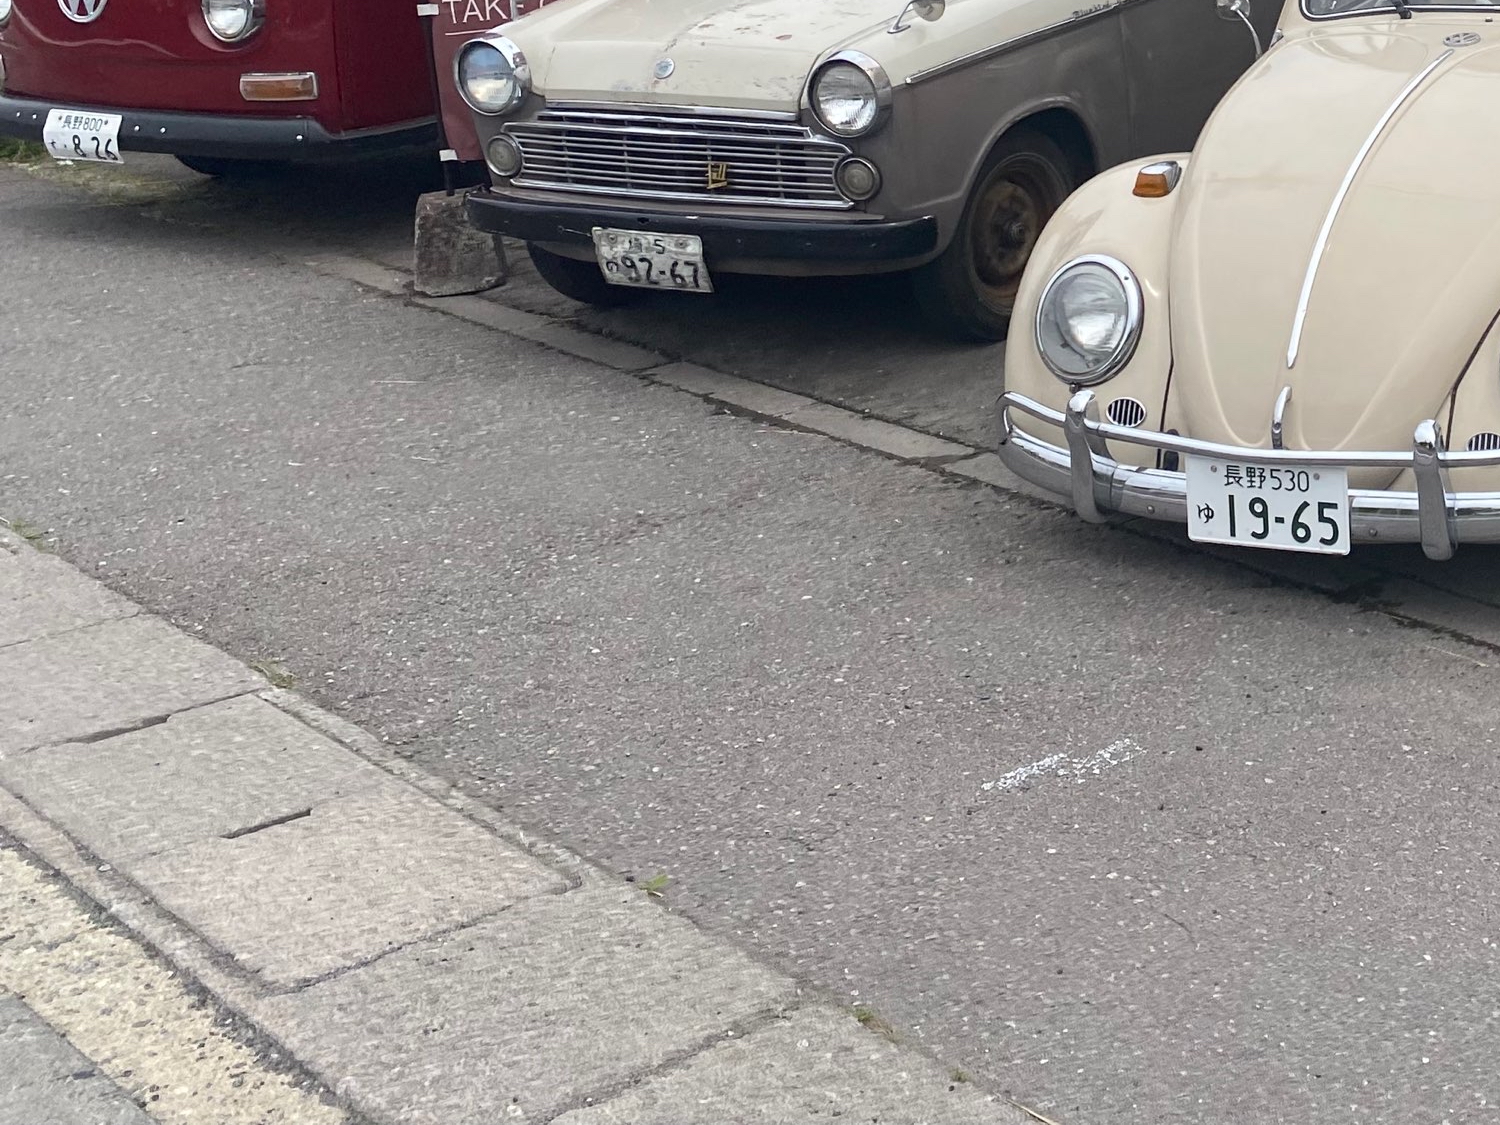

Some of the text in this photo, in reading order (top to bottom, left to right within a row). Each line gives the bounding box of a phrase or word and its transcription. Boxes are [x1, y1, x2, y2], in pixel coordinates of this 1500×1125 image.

[621, 255, 700, 288] 92-67
[1224, 465, 1310, 492] 長野530
[1197, 494, 1340, 546] ゆ 19-65
